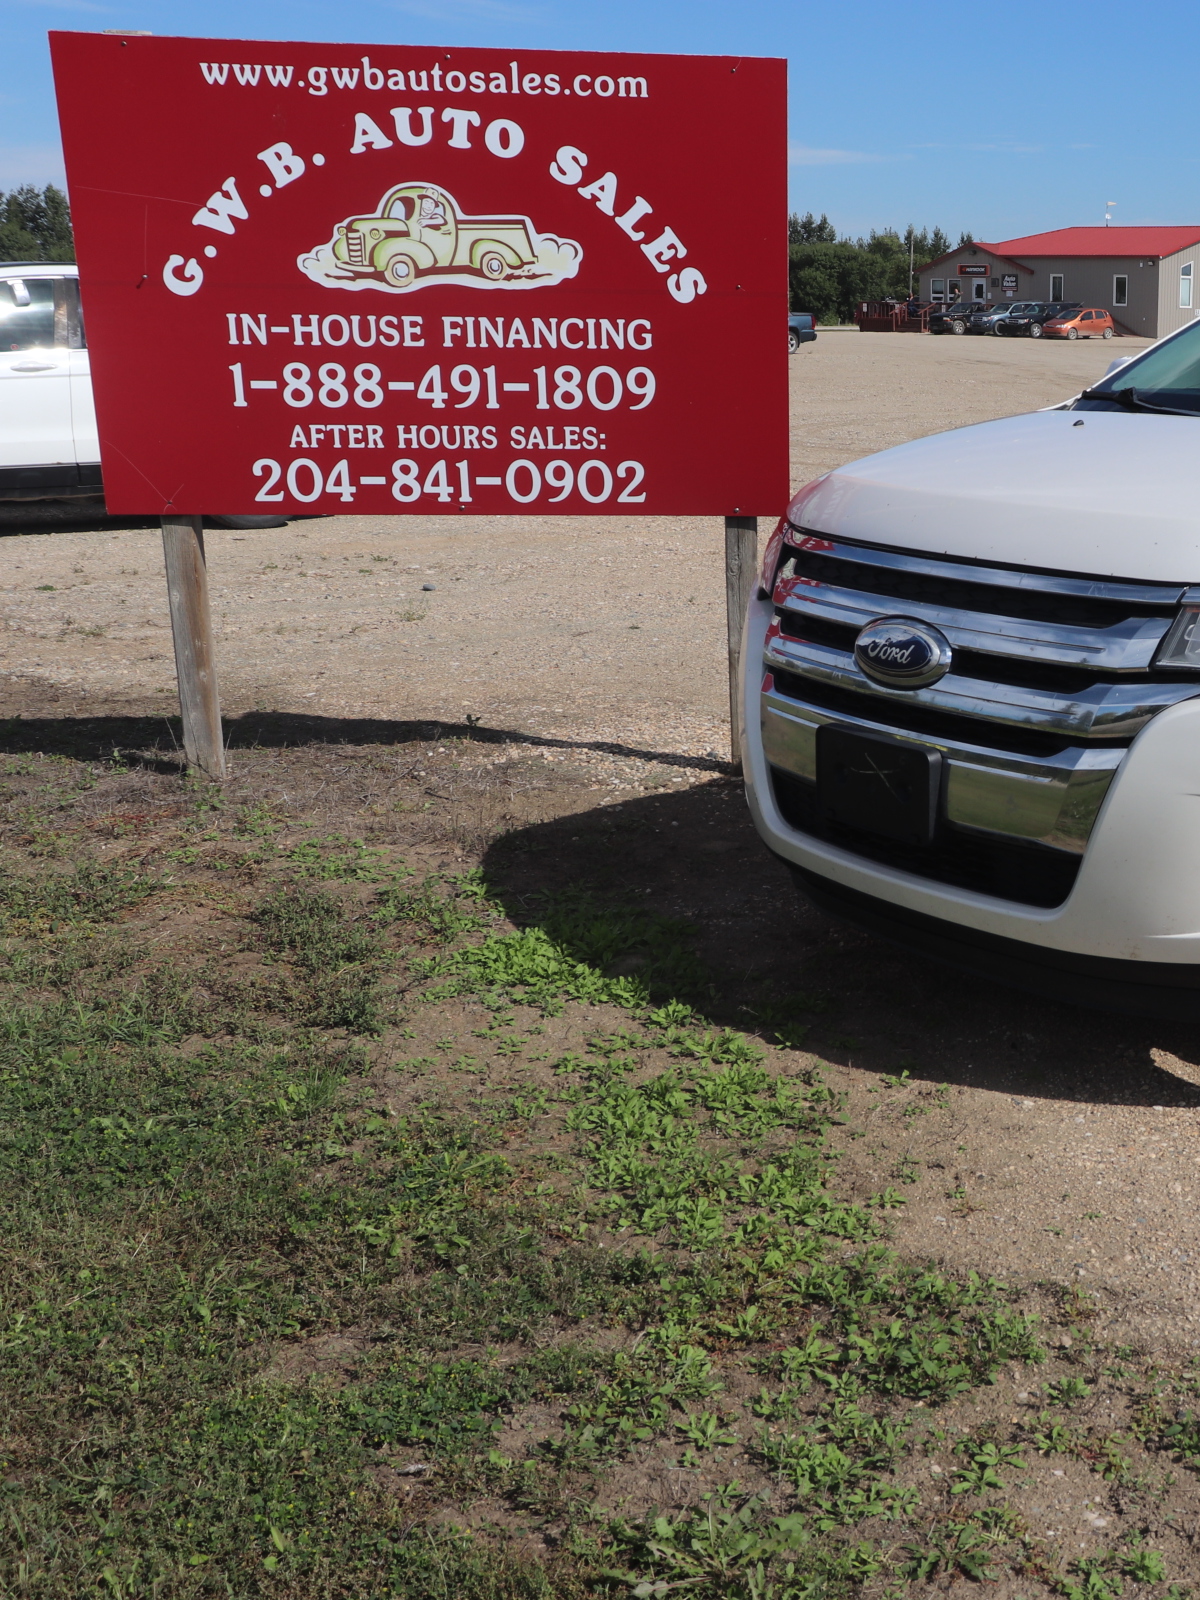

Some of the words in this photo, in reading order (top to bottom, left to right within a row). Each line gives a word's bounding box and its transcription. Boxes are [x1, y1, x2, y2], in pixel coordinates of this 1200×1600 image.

[200, 57, 650, 99] www.gwbautosales.com
[162, 141, 326, 297] G.W.B.
[349, 106, 525, 159] AUTO
[549, 145, 708, 304] SALES
[226, 313, 425, 347] IN-HOUSE
[441, 316, 653, 351] FINANCING
[228, 361, 656, 411] 1-888-491-1809
[289, 424, 385, 449] AFTER
[396, 425, 499, 450] HOURS
[510, 426, 607, 450] SALES:
[252, 458, 647, 504] 204-841-0902
[868, 638, 915, 664] Ford
